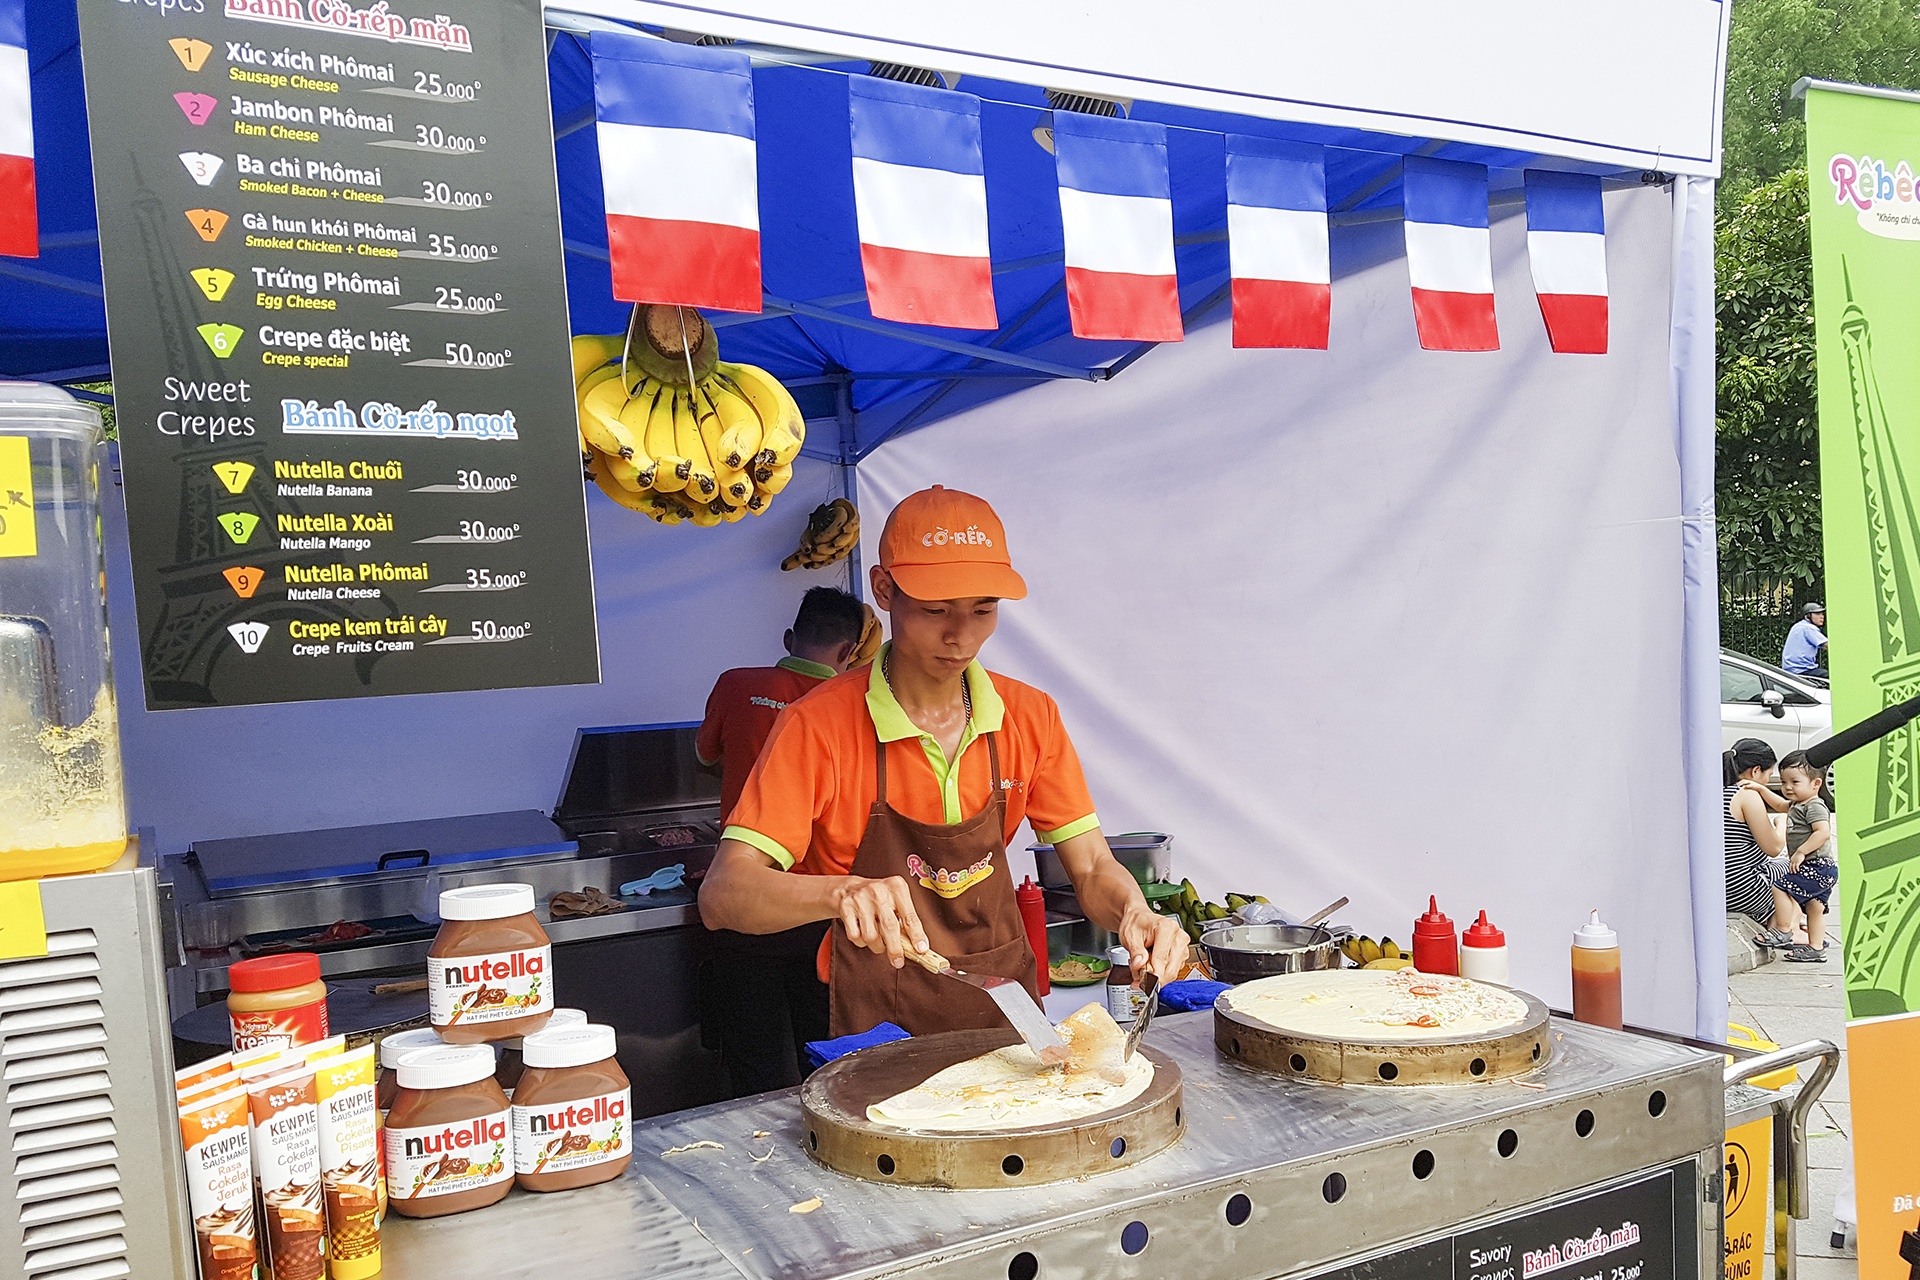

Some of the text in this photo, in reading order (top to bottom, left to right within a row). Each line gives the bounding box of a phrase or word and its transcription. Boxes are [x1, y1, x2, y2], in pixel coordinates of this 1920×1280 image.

[412, 15, 469, 49] mặn
[184, 46, 193, 63] 1
[225, 41, 395, 83] Xúc xích Phômai
[229, 67, 340, 93] Sausage Cheese
[189, 101, 202, 117] 2
[230, 95, 395, 133] Jambon Phômai
[234, 121, 320, 143] Ham Cheese
[195, 161, 206, 177] 3
[236, 153, 382, 187] Ba chỉ Phômai
[239, 179, 289, 195] Smoked
[291, 185, 327, 198] Bacon
[342, 188, 385, 204] Cheese
[200, 217, 214, 234] 4
[242, 212, 417, 243] Gà hun khói Phômai
[245, 235, 294, 250] Smoked
[296, 239, 342, 254] Chicken
[357, 243, 399, 258] Cheese
[207, 277, 218, 293] 5
[251, 266, 400, 296] Trứng Phômai
[256, 292, 337, 310] Egg Cheese
[213, 332, 228, 350] 6
[258, 325, 411, 357] Crepe đặc biệt
[262, 351, 349, 369] Crepe special
[164, 376, 251, 402] Sweet
[156, 411, 255, 443] Crepes
[284, 400, 515, 438] Bánh Cờ-rếp ngọt
[228, 470, 239, 486] 7
[273, 461, 345, 479] Nutella
[277, 484, 373, 497] Nutella Banana
[232, 521, 244, 536] 8
[277, 512, 394, 532] Nutella Xoài
[280, 537, 372, 551] Nutella Mango
[237, 574, 249, 590] 9
[284, 562, 429, 583] Nutella Phômai
[287, 587, 381, 601] Nutella Cheese
[238, 630, 259, 646] 10
[289, 614, 448, 641] Crepe kem trái cây
[292, 640, 414, 657] Crepe Fruits Cream
[445, 952, 543, 985] nutella
[329, 1090, 374, 1115] KEWPIE
[270, 1109, 316, 1138] KEWPIE
[345, 1117, 367, 1129] Rasa
[530, 1097, 625, 1133] nutella
[335, 1123, 374, 1143] Cokelat
[405, 1118, 506, 1157] nutella
[200, 1131, 248, 1161] KEWPIE
[286, 1137, 310, 1152] Rasa
[340, 1136, 374, 1154] Pisang
[277, 1145, 318, 1167] Cokelat
[289, 1157, 313, 1176] Kopi
[218, 1161, 242, 1176] Rasa
[208, 1169, 249, 1192] Cokelat
[216, 1183, 249, 1202] Jeruk
[1524, 1245, 1560, 1274] Bánh
[1564, 1228, 1608, 1260] Cờ-rếp
[1611, 1223, 1640, 1247] mặn
[1732, 1231, 1752, 1255] RÁC
[1469, 1244, 1512, 1269] Savory
